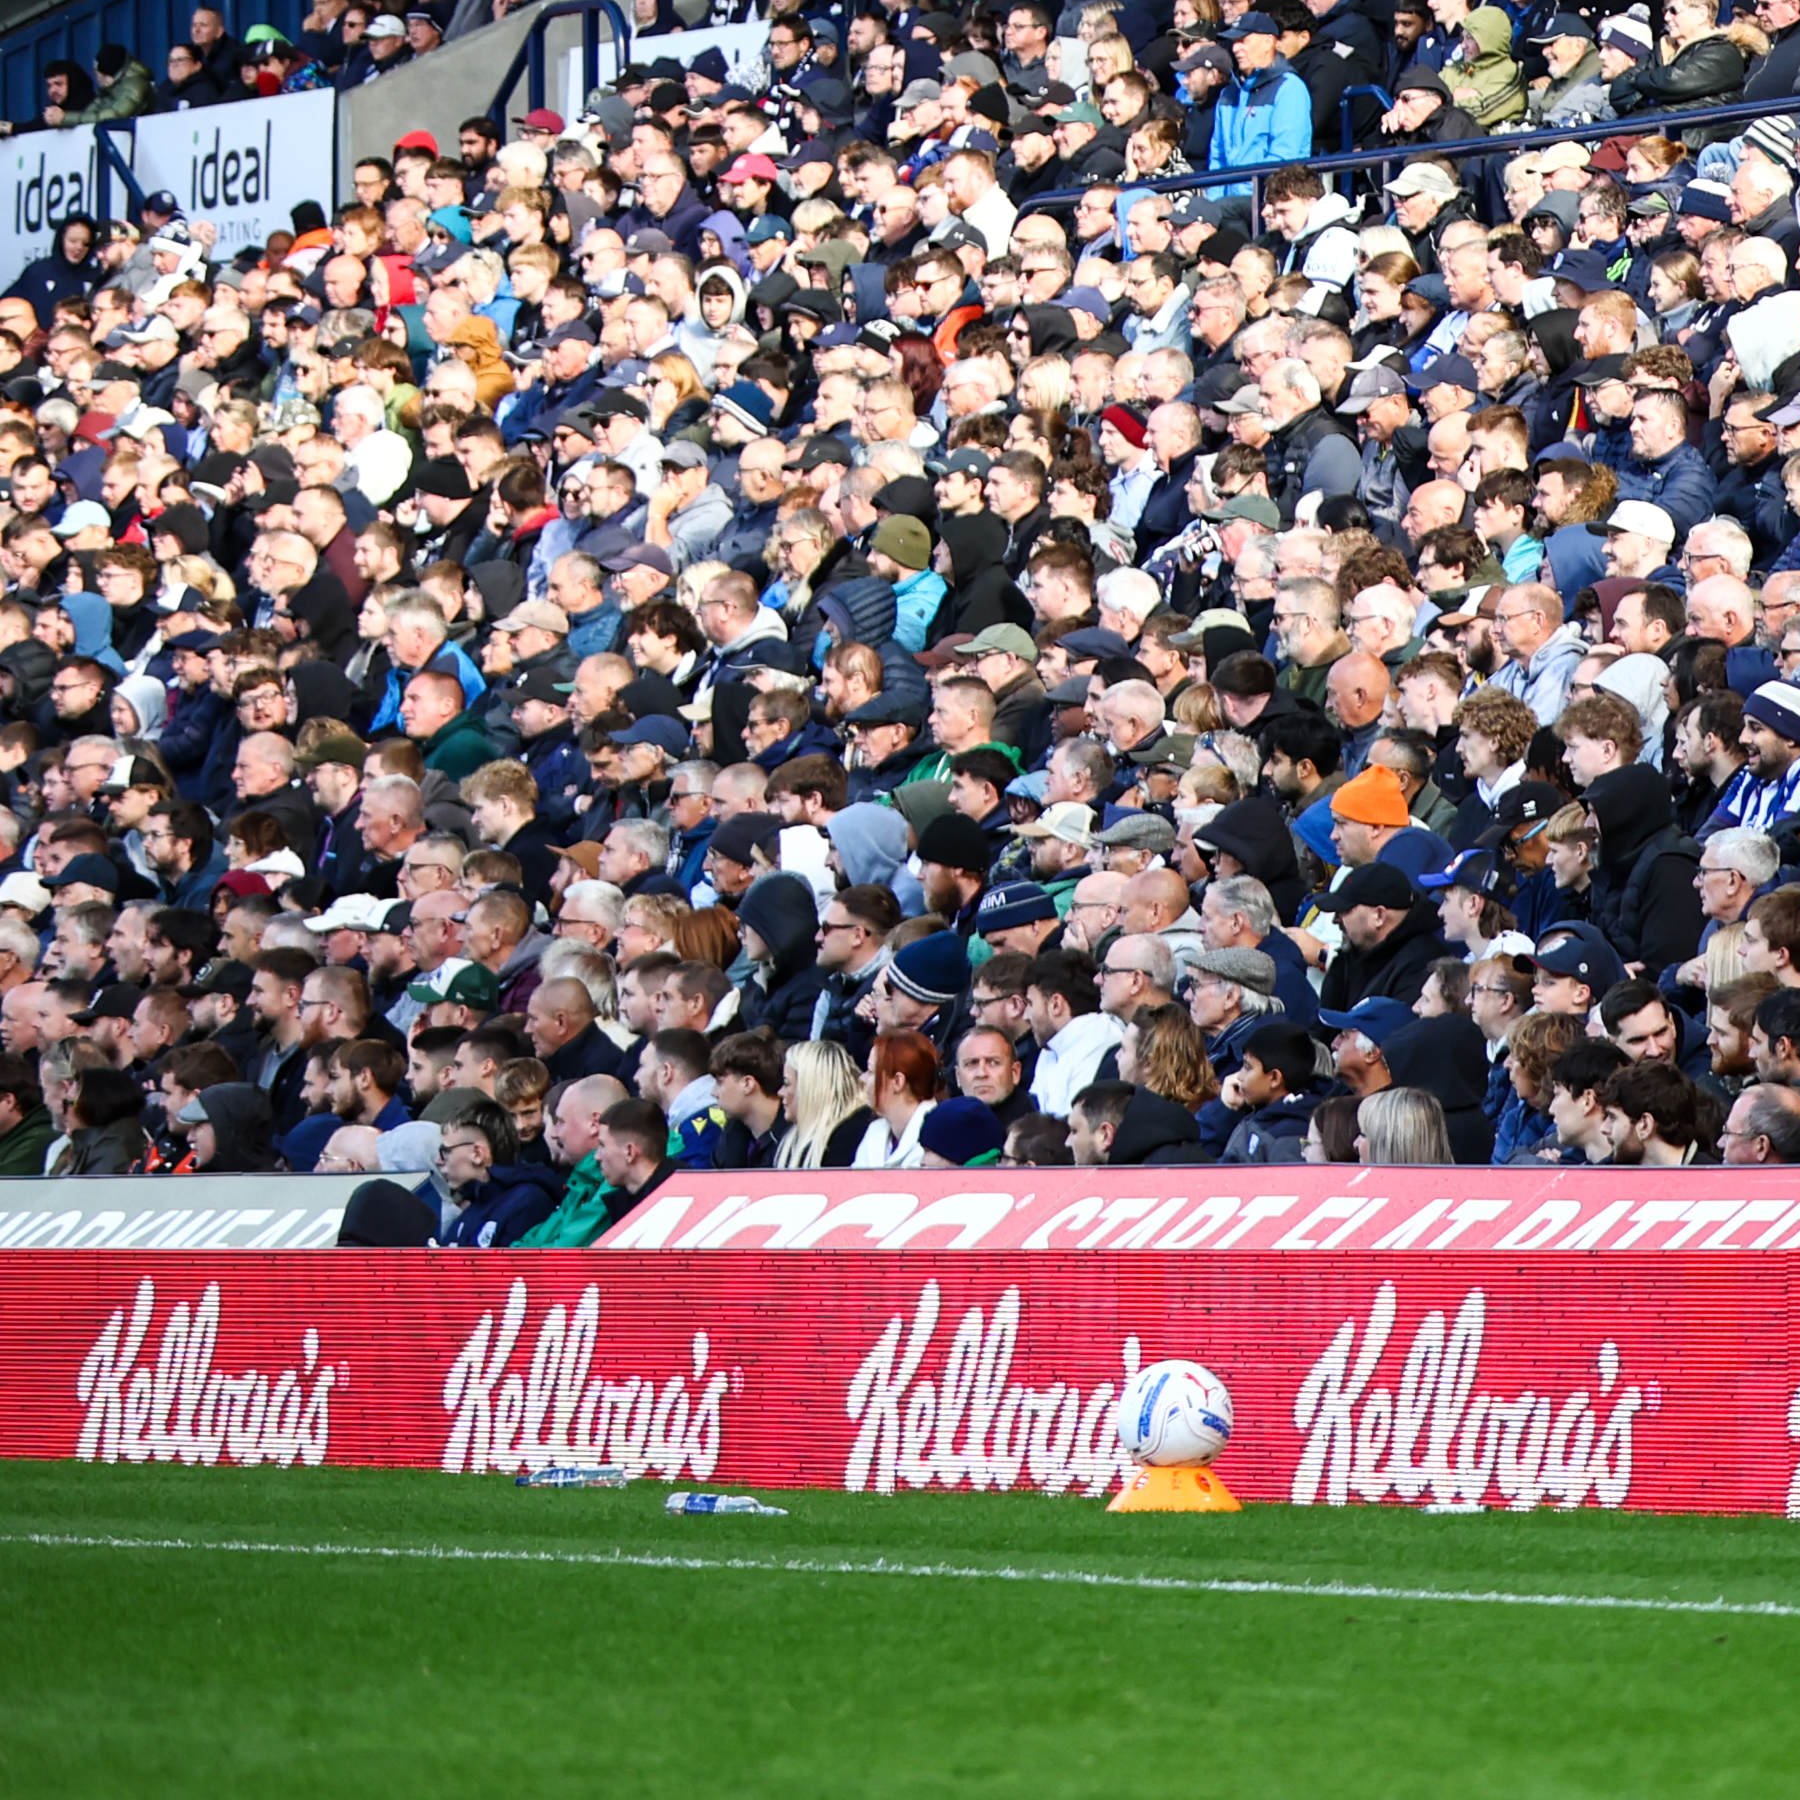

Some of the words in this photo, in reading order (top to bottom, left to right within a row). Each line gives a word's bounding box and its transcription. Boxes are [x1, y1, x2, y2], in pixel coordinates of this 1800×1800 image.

[15, 144, 96, 235] ideal
[192, 119, 271, 211] ideal
[76, 1274, 333, 1466] Kellogg's
[440, 1275, 727, 1482] Kellogg's
[1290, 1278, 1643, 1512] Kellogg's
